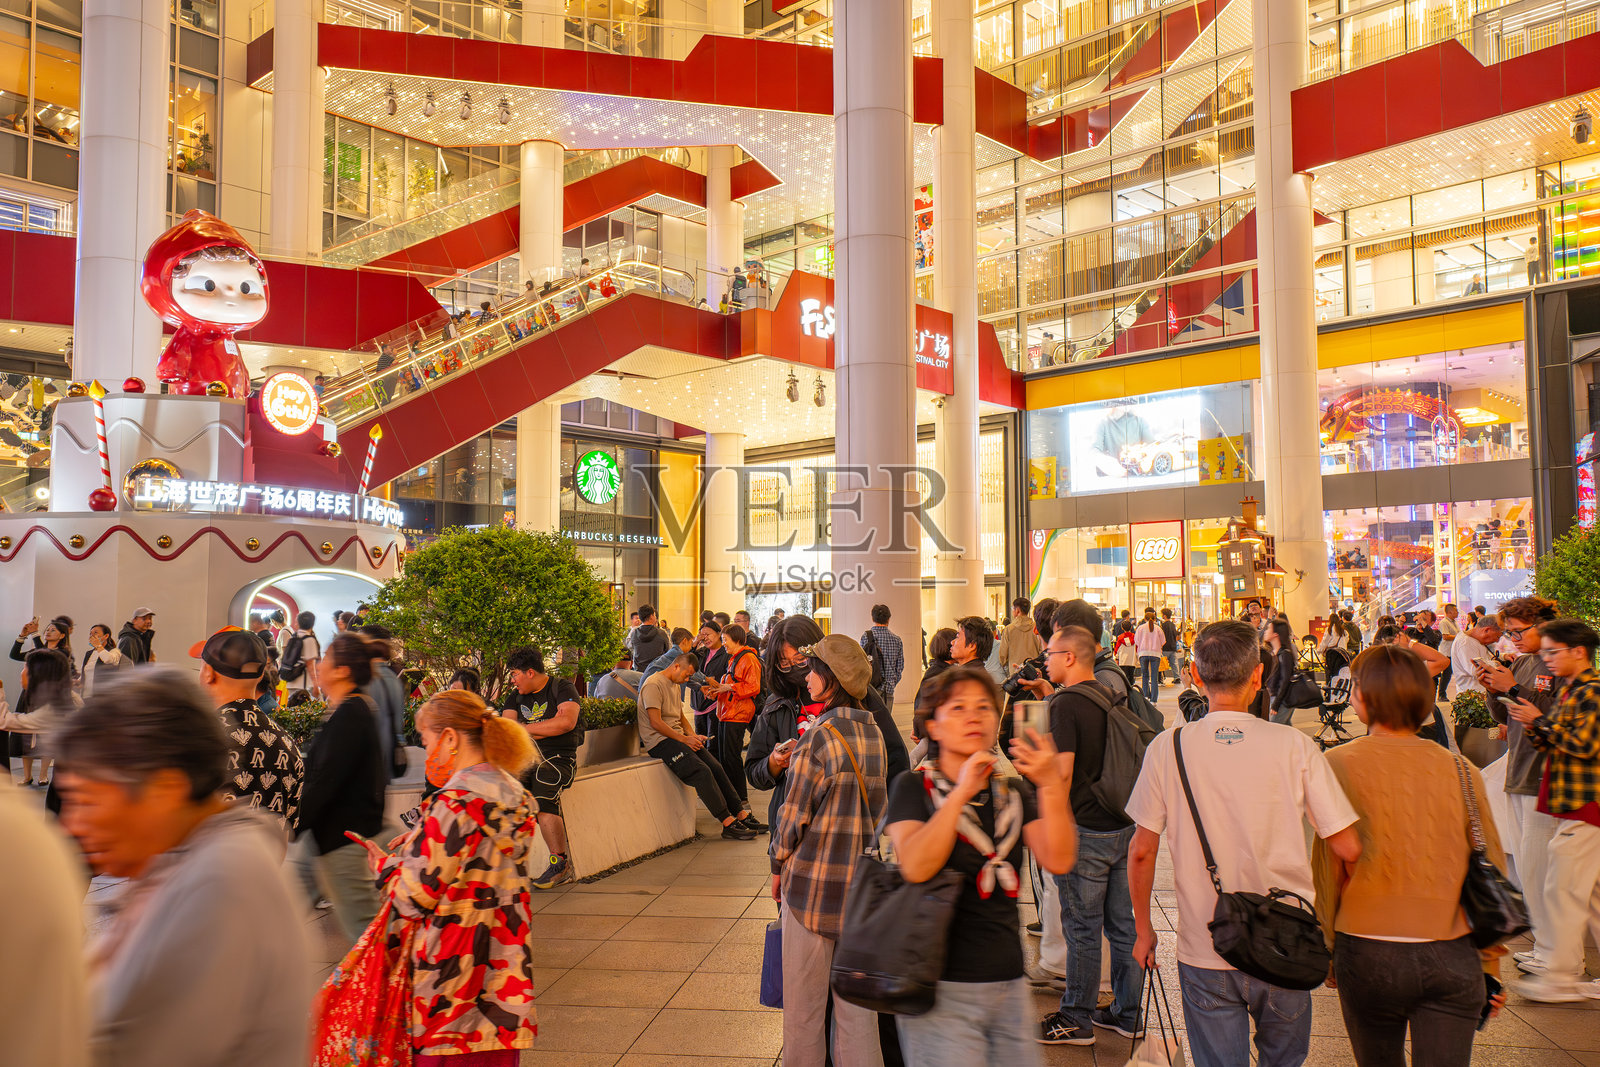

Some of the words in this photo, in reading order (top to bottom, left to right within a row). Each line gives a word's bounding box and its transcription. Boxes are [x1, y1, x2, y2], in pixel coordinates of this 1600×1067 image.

[915, 329, 950, 359] 广场
[916, 354, 935, 366] STIVAL
[935, 358, 949, 369] CITY
[277, 385, 306, 404] Hey
[135, 479, 351, 516] 上海世茂广场6周年庆
[620, 534, 664, 545] RESERVE
[1133, 537, 1179, 563] LEGO
